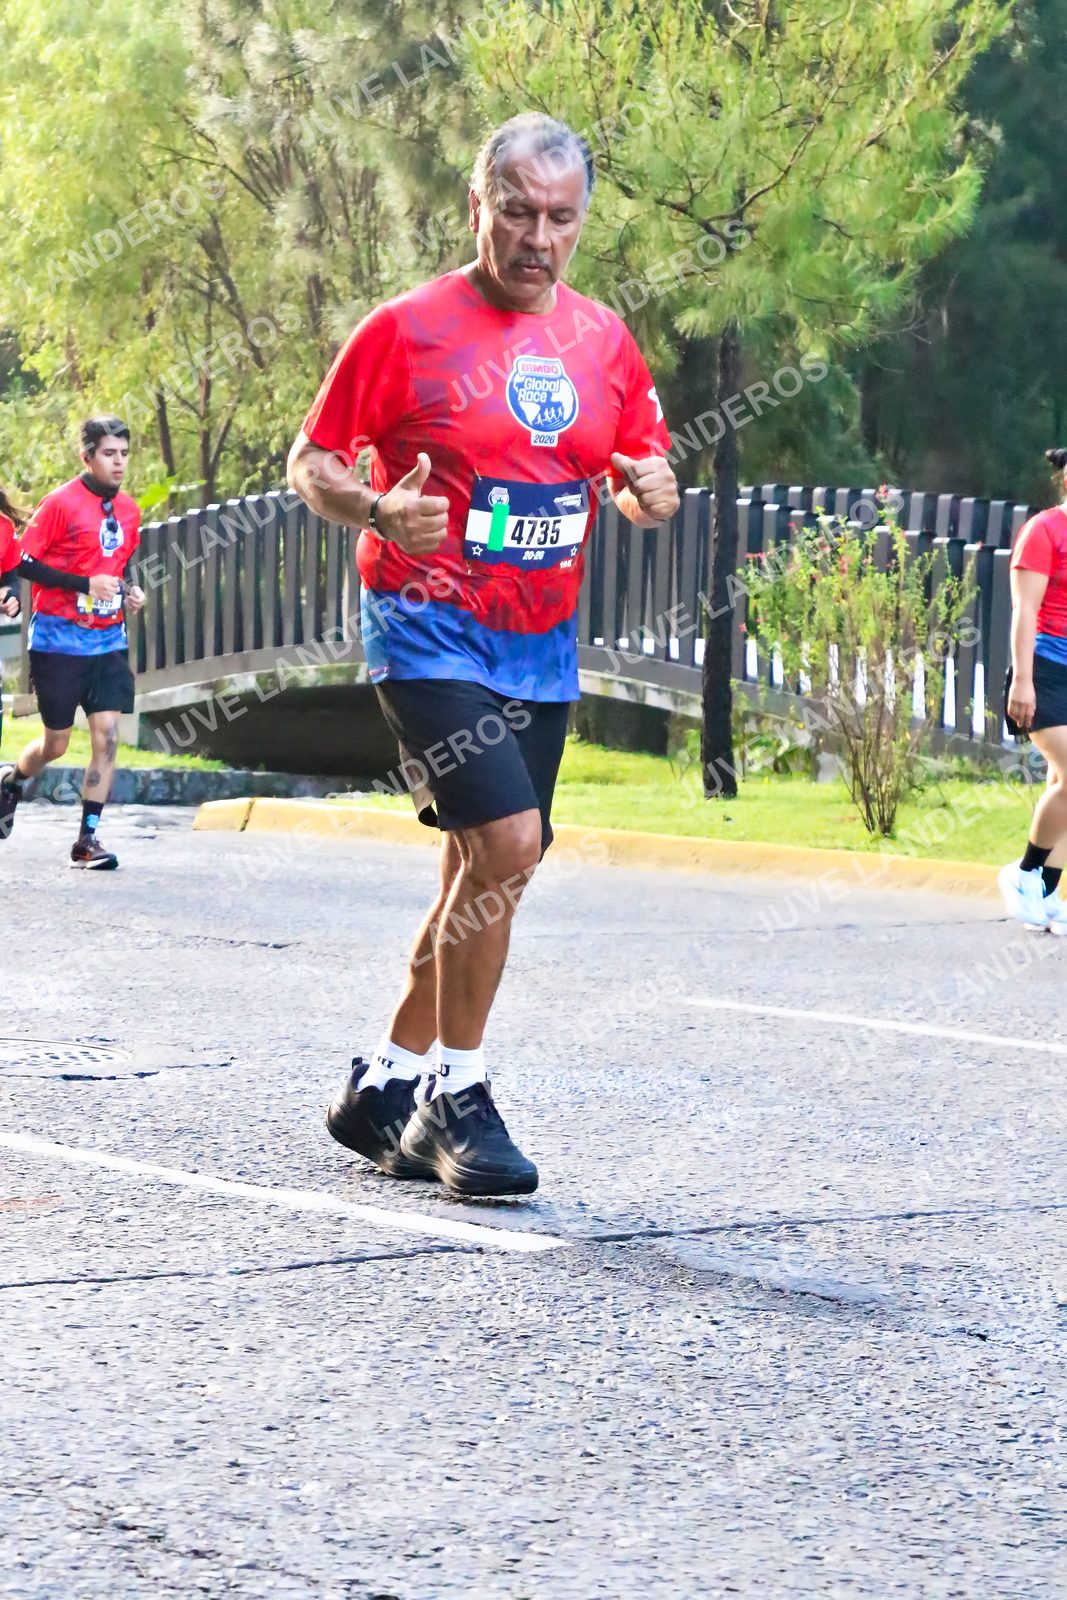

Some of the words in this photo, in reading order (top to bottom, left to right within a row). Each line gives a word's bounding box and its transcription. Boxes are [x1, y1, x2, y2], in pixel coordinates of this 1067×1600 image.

[521, 363, 559, 374] BIMBO
[524, 377, 560, 393] Global
[518, 388, 548, 403] Race
[533, 434, 556, 444] 2026
[511, 519, 562, 545] 4735
